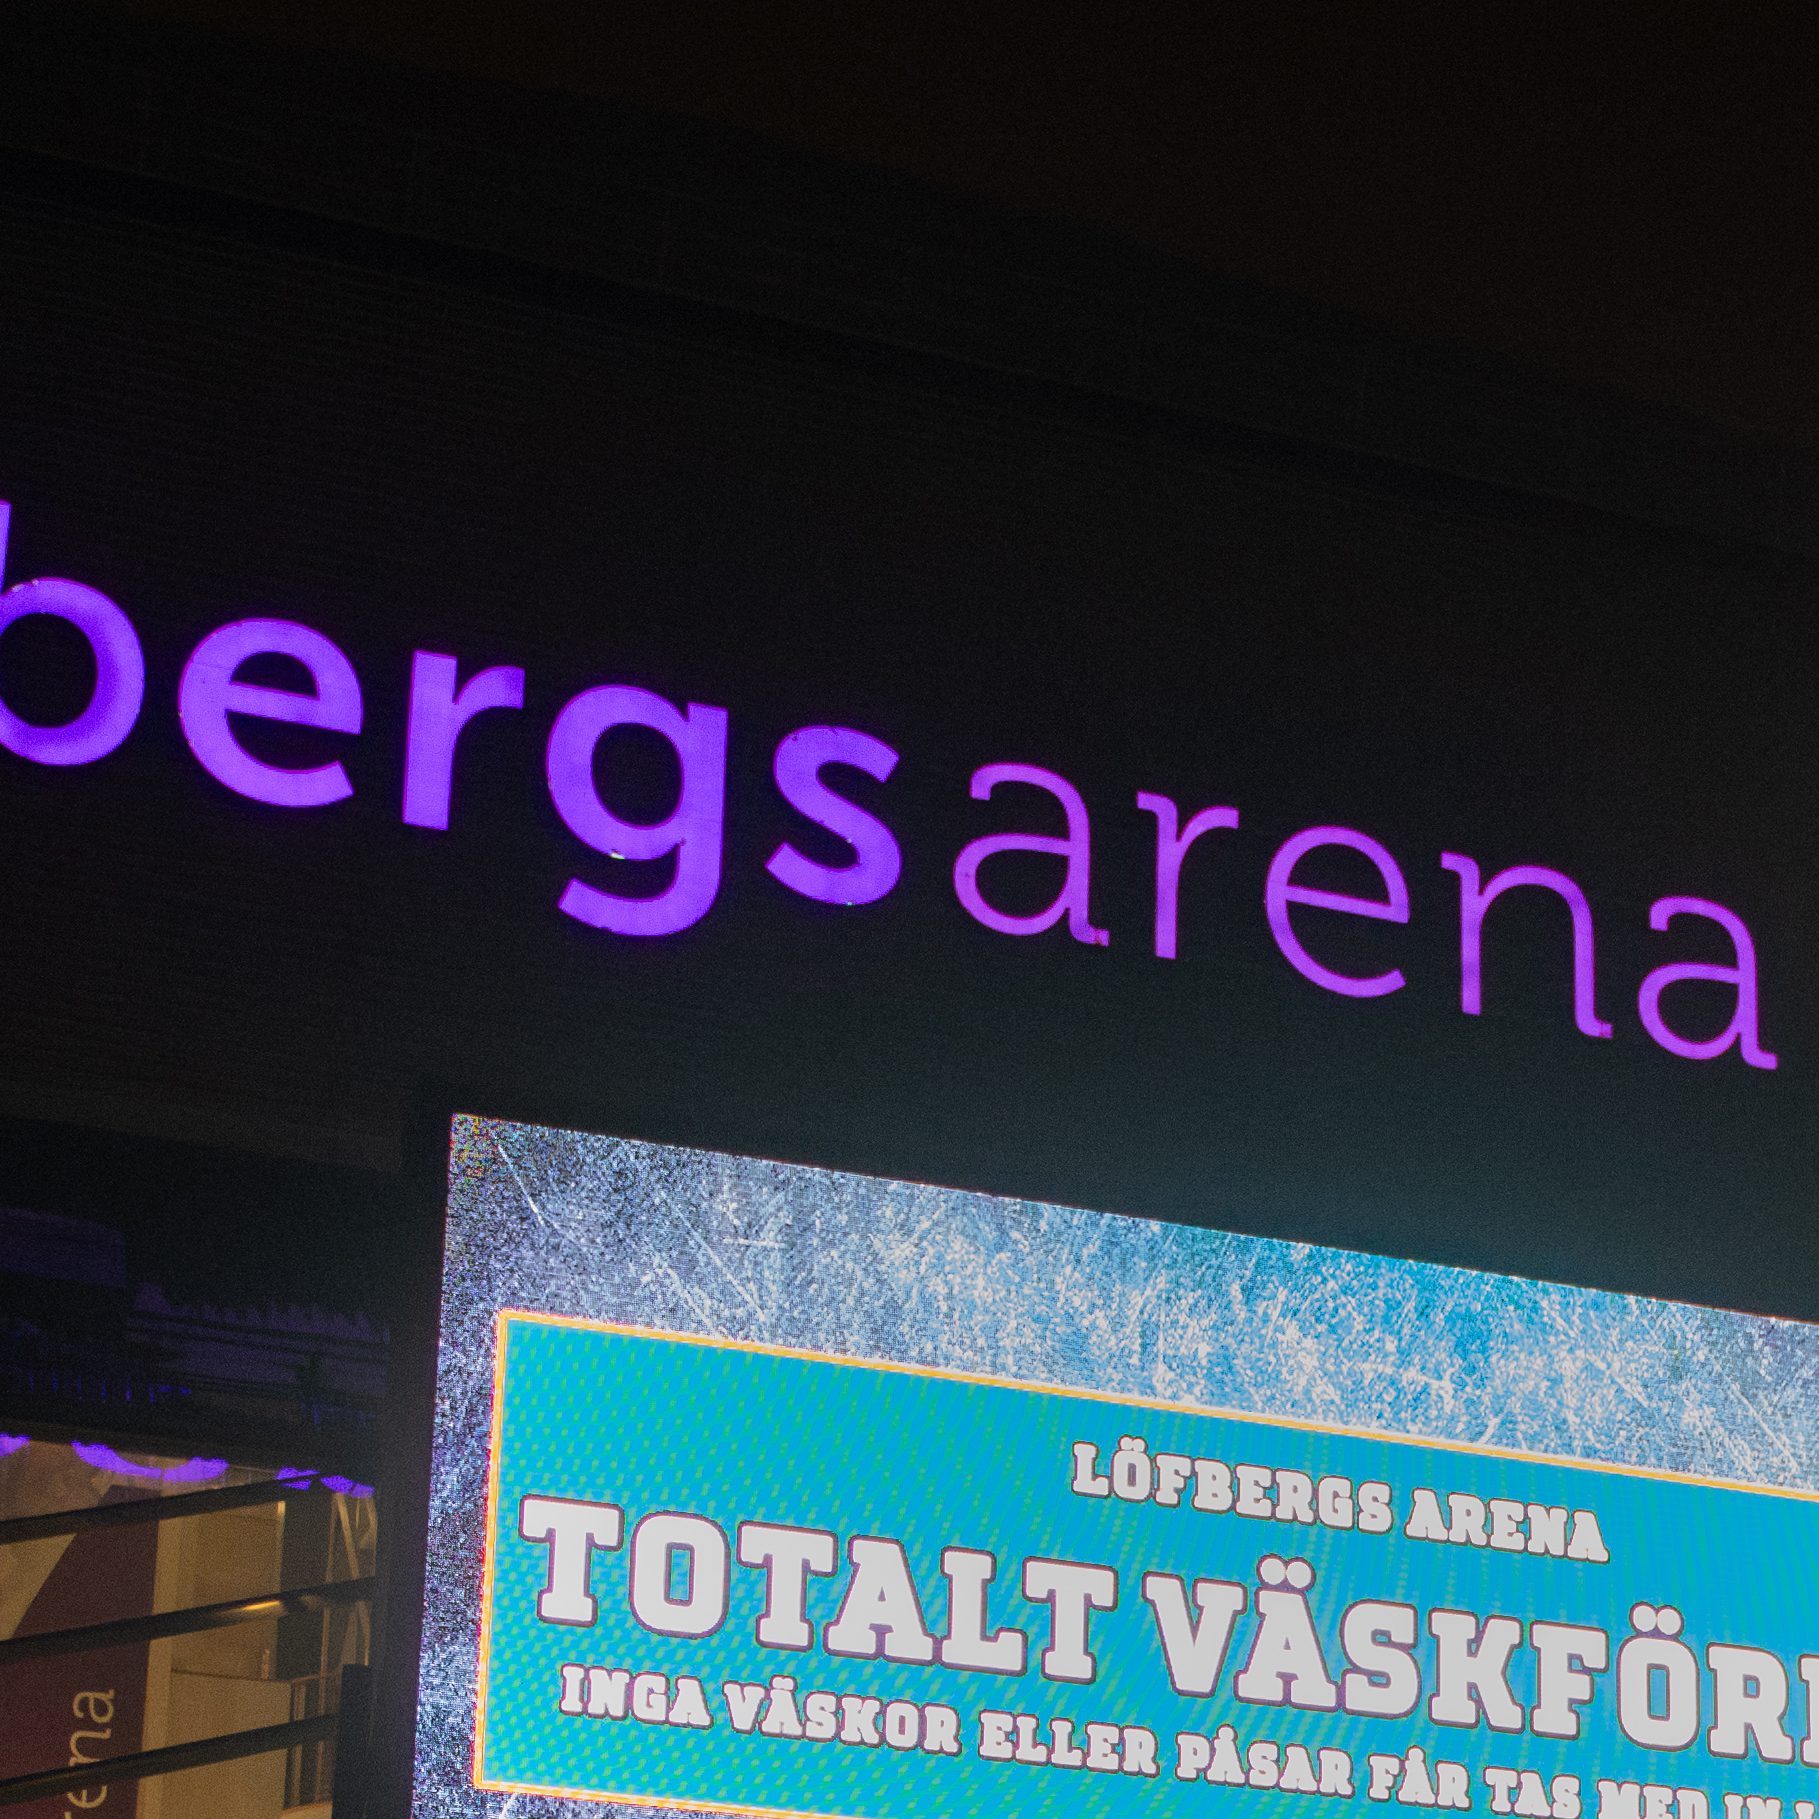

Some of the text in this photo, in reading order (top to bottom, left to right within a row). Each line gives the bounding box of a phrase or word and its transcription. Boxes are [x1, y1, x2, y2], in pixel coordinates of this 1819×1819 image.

[1071, 1435, 1610, 1564] LÖFBERGS ARENA
[520, 1494, 1119, 1685] TOTALT
[560, 1663, 714, 1729] INGA
[723, 1675, 962, 1756] VÄSKOR
[979, 1709, 1160, 1778] ELLER
[1176, 1725, 1355, 1798] PÅSAR
[1368, 1746, 1471, 1811] FÅR
